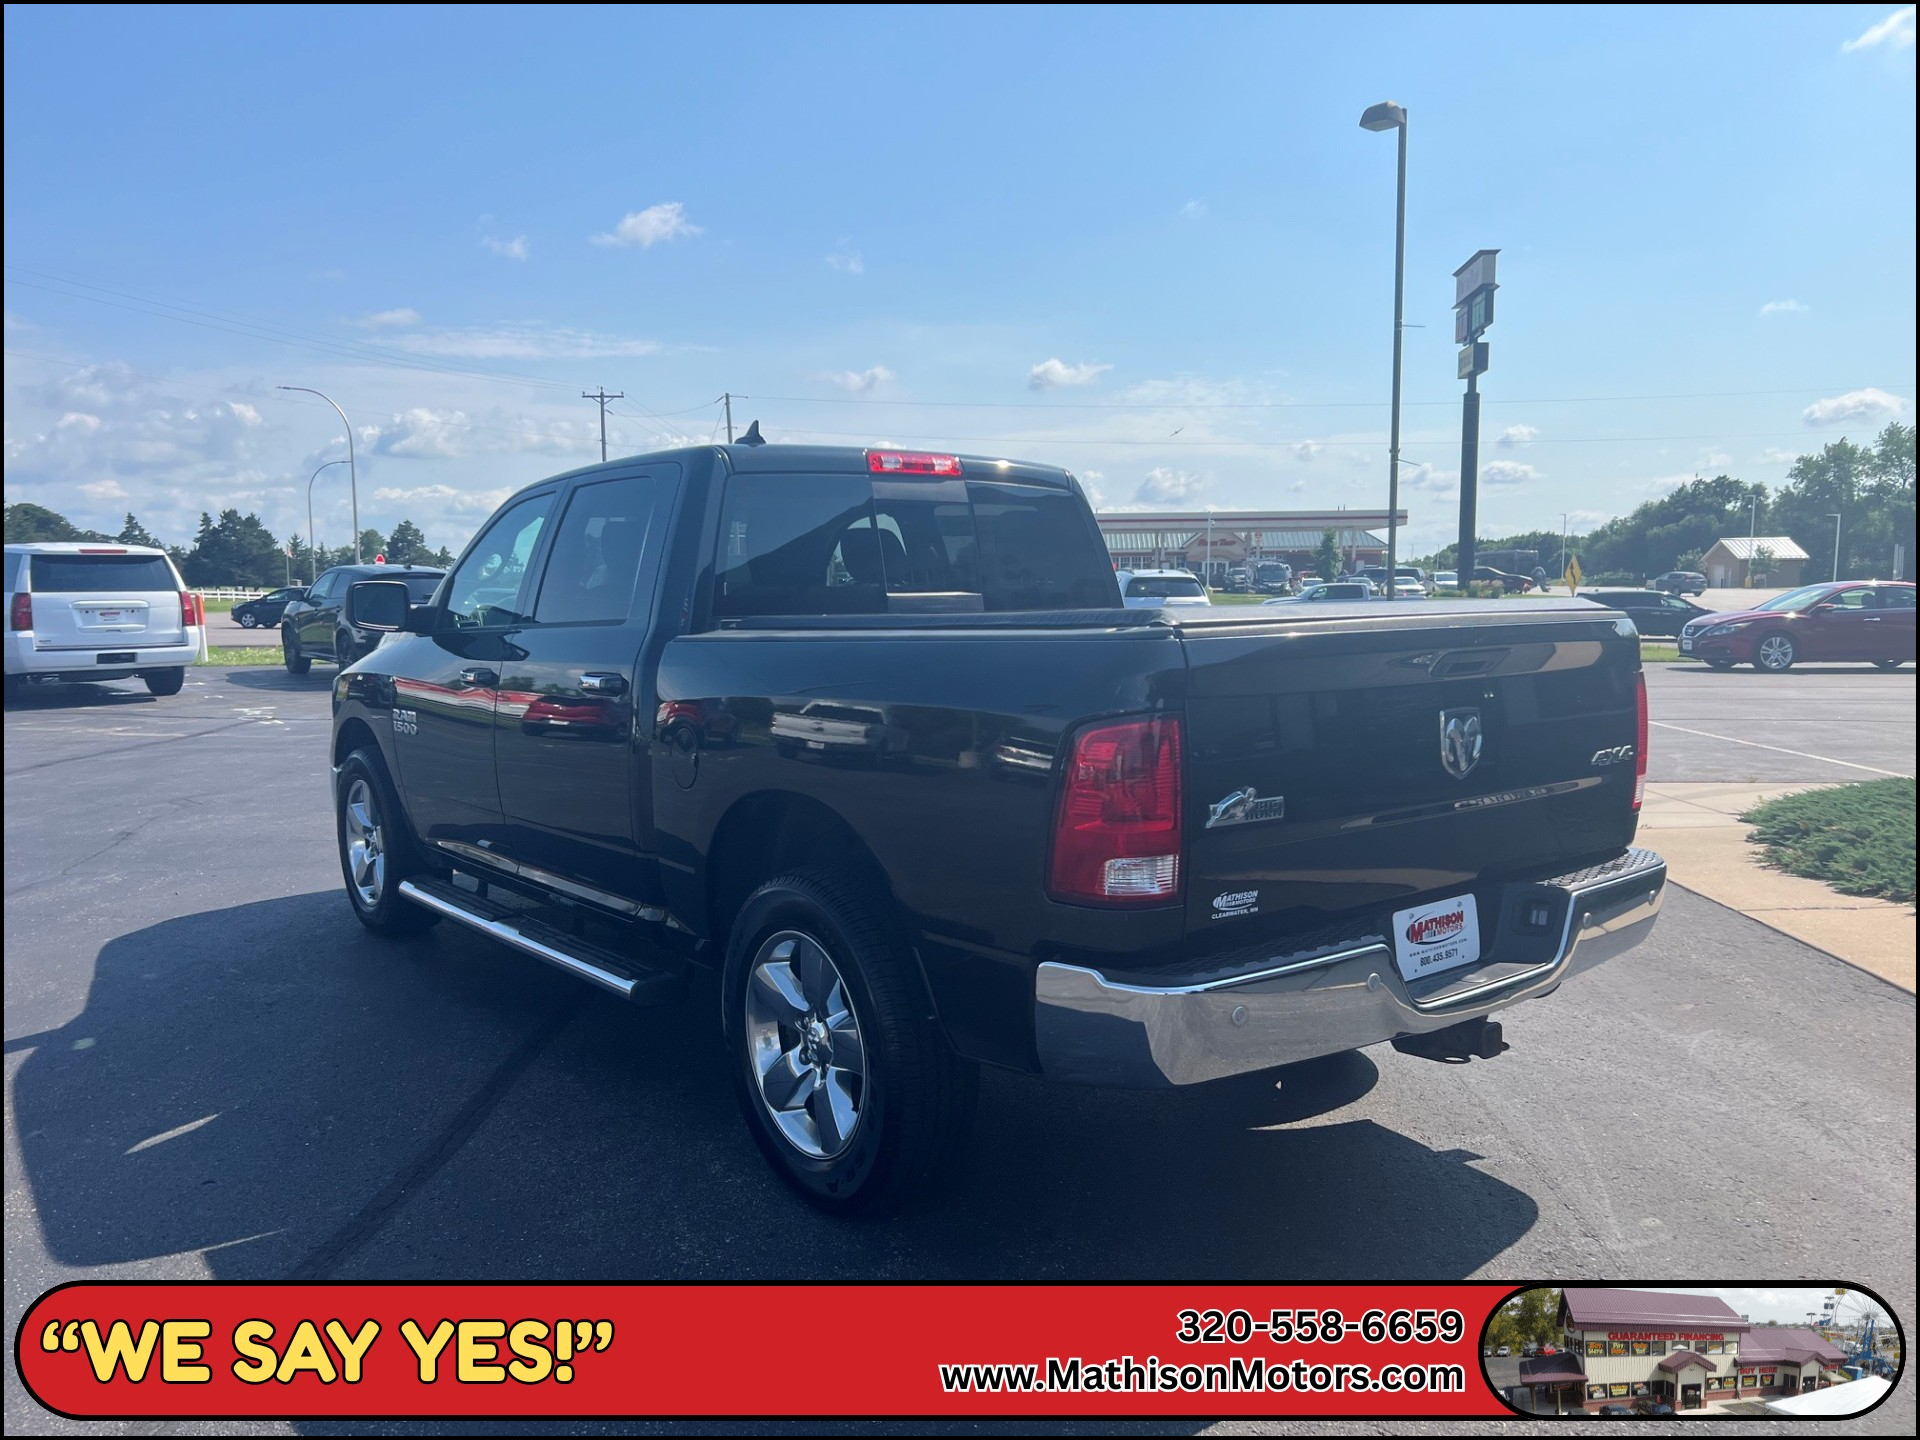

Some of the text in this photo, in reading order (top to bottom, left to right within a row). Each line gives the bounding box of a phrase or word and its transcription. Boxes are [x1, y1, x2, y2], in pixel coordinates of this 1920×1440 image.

[392, 708, 417, 723] RAM
[393, 720, 418, 735] 1500
[1214, 890, 1259, 909] MATHISON
[1234, 898, 1256, 906] MOTORS
[1211, 908, 1249, 920] CLEARWATER,
[1409, 910, 1464, 944] MATHISON
[1437, 923, 1463, 937] MOTORS
[1420, 948, 1458, 967] 800.435.9571
